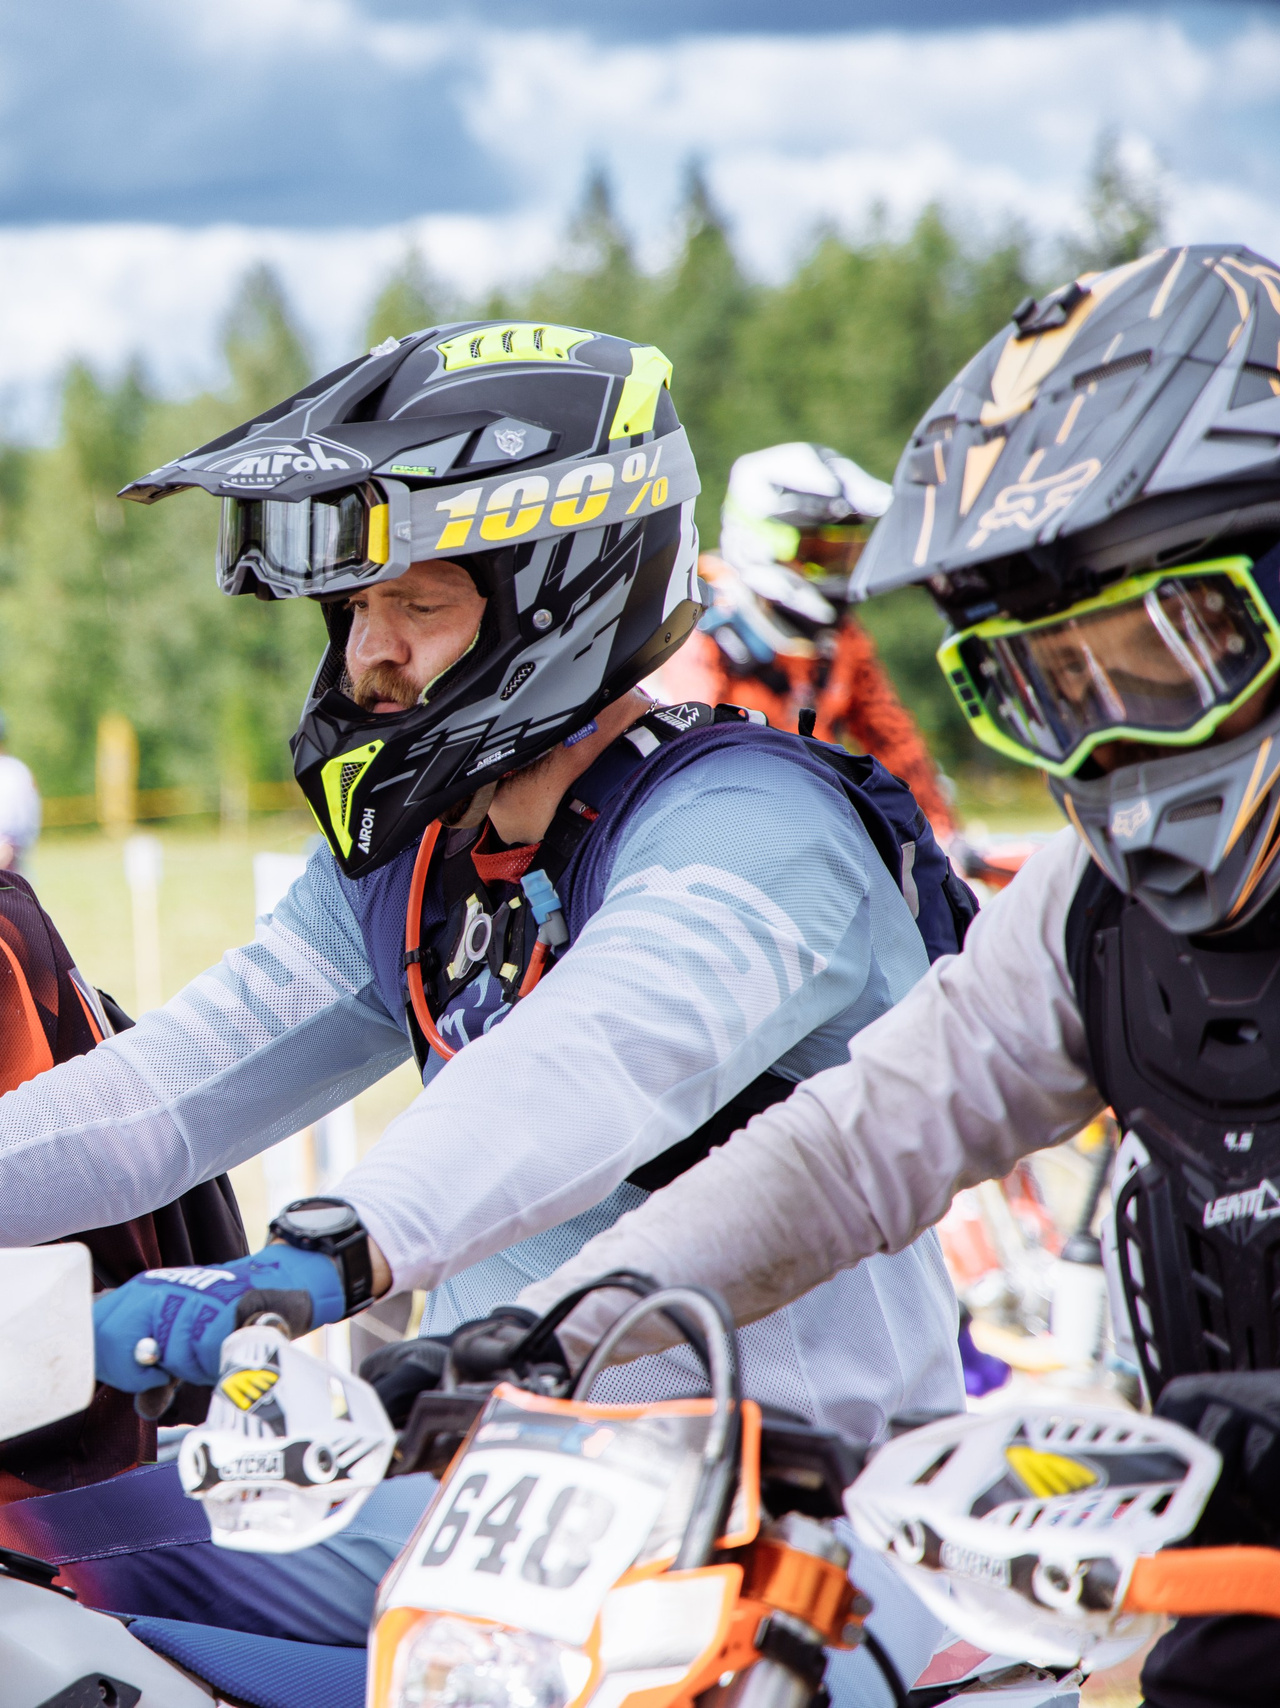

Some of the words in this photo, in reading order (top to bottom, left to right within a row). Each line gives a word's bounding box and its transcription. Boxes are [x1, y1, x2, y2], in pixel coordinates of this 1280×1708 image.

[435, 445, 668, 550] 100%
[567, 723, 594, 743] HYDRA
[357, 807, 376, 855] AIROH
